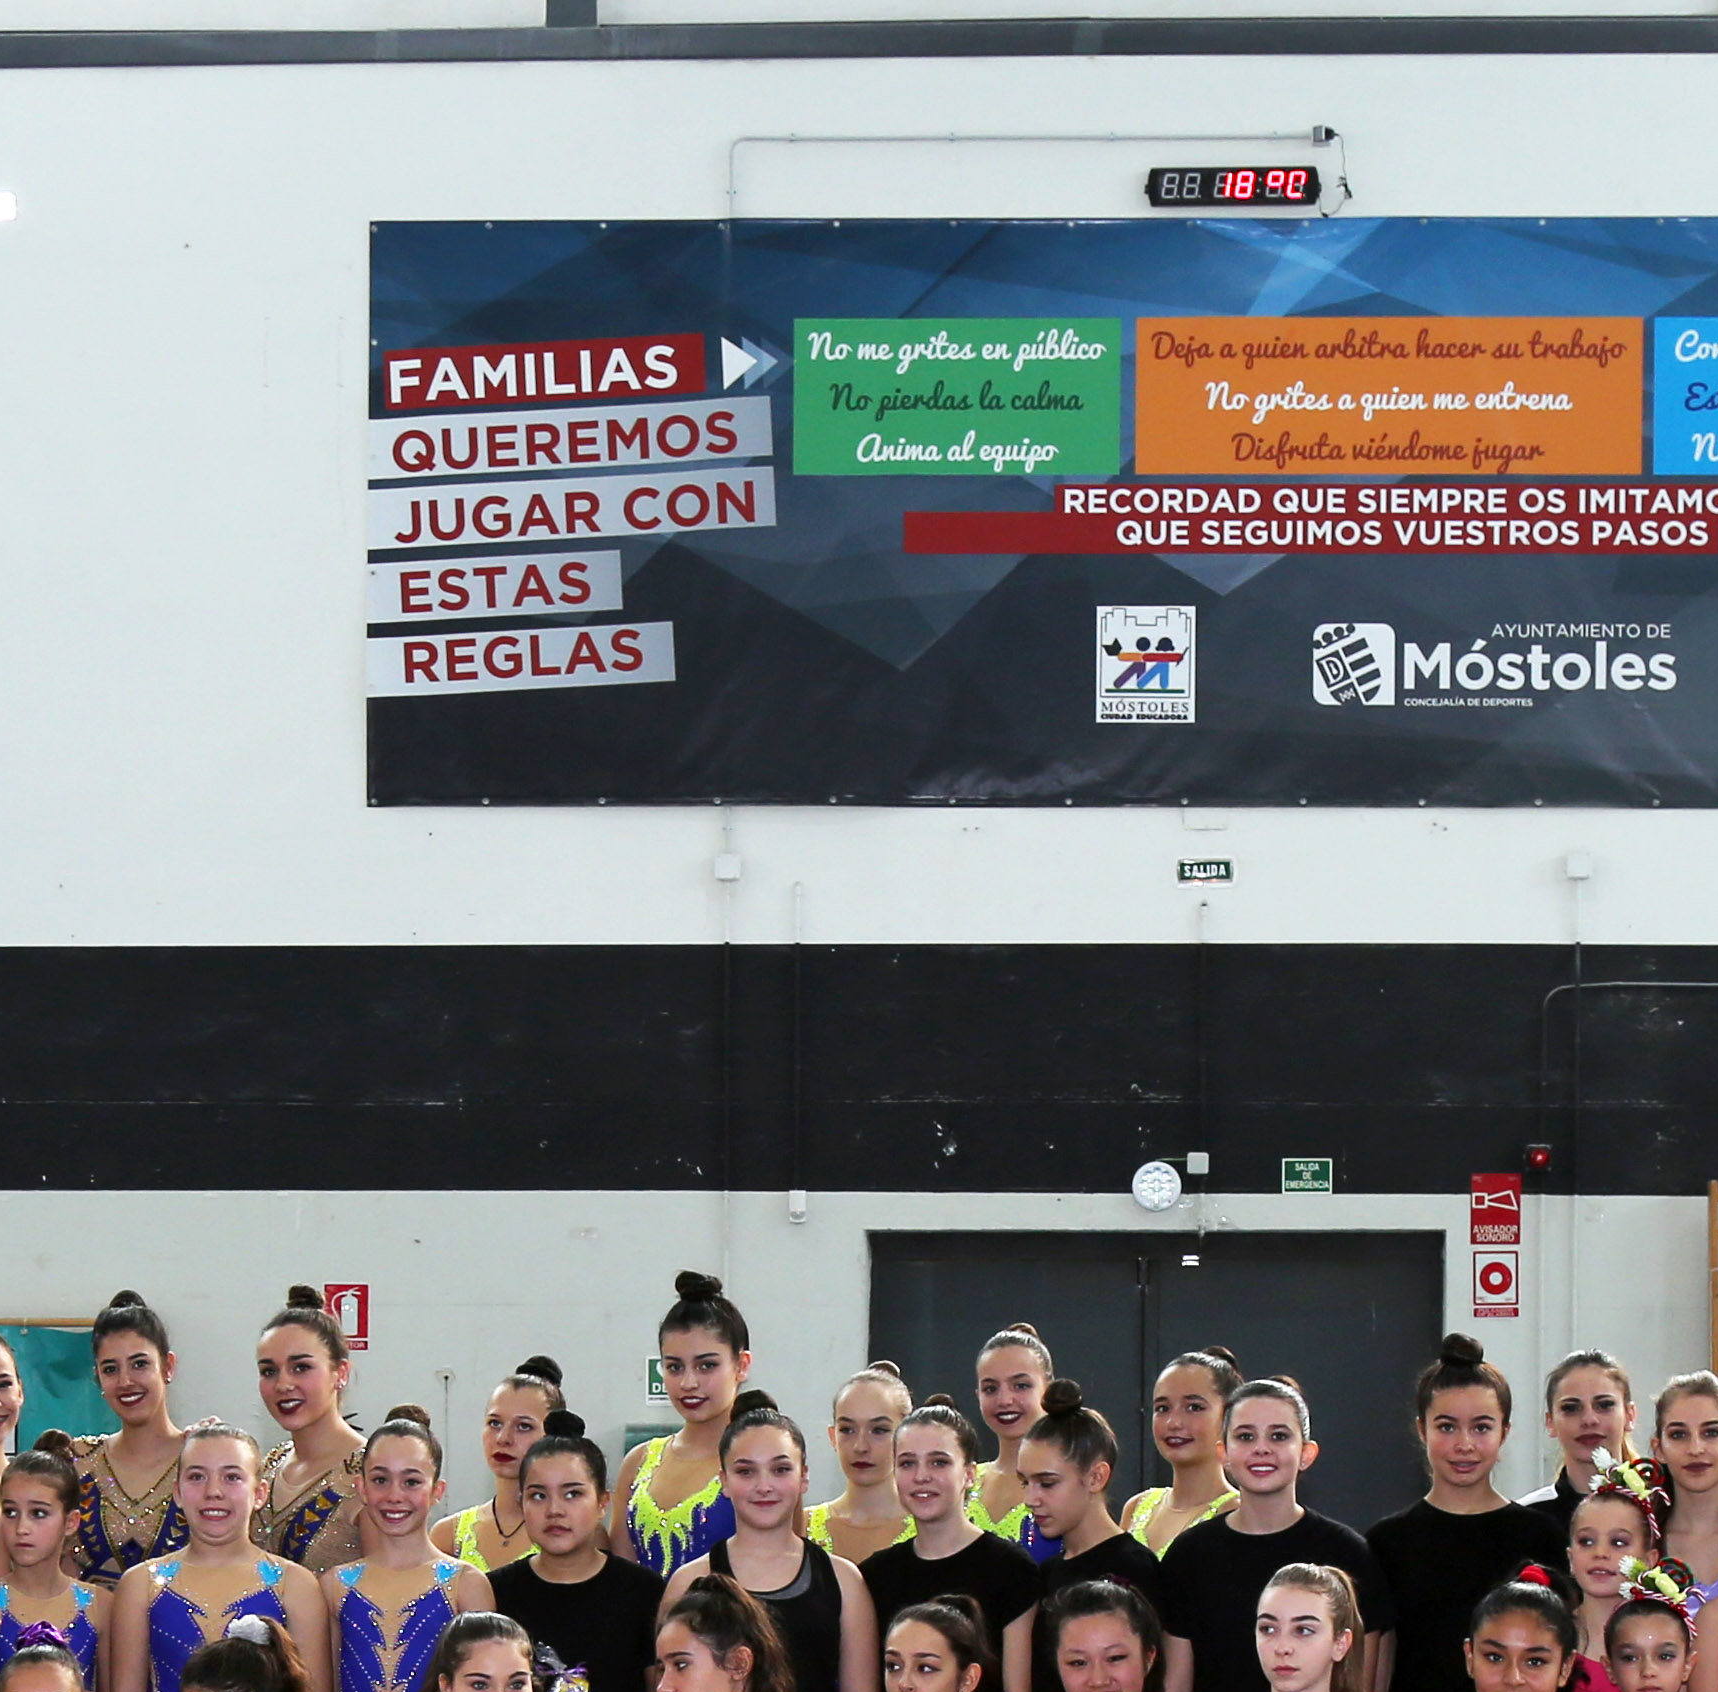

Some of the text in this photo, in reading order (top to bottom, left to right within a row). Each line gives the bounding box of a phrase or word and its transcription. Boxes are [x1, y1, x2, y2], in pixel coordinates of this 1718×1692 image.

[808, 328, 1107, 375] No me grites en público
[1151, 327, 1628, 371] Deja a quien arbitra hacer su trabajo
[388, 344, 679, 404] FAMILIAS
[829, 379, 1085, 422] No pierdas la calma
[1205, 380, 1574, 425] No grites a quien me entrena
[392, 410, 738, 473] QUEREMOS
[856, 430, 1060, 474] Anima al equipo
[1231, 429, 1546, 474] Disfruta viéndome jugar
[394, 480, 757, 544] JUGAR CON
[1063, 487, 1262, 514] RECORDAD
[1272, 487, 1346, 515] QUE
[1357, 487, 1508, 514] SIEMPRE
[1518, 487, 1567, 515] OS
[1115, 519, 1709, 547] QUE SEGUIMOS VUESTROS PASOS
[399, 561, 592, 614] ESTAS
[1491, 623, 1672, 639] AYUNTAMIENTO DE
[403, 628, 644, 684] REGLAS
[1403, 638, 1678, 692] Móstoles
[1101, 698, 1189, 713] MÓSTOLES
[1404, 696, 1533, 707] CONCEJALÍA DE DEPORTES
[1183, 864, 1227, 878] SALIDA
[1294, 1162, 1320, 1171] SALIDA
[1472, 1224, 1519, 1235] AVISADOR
[1476, 1233, 1515, 1242] SONORO
